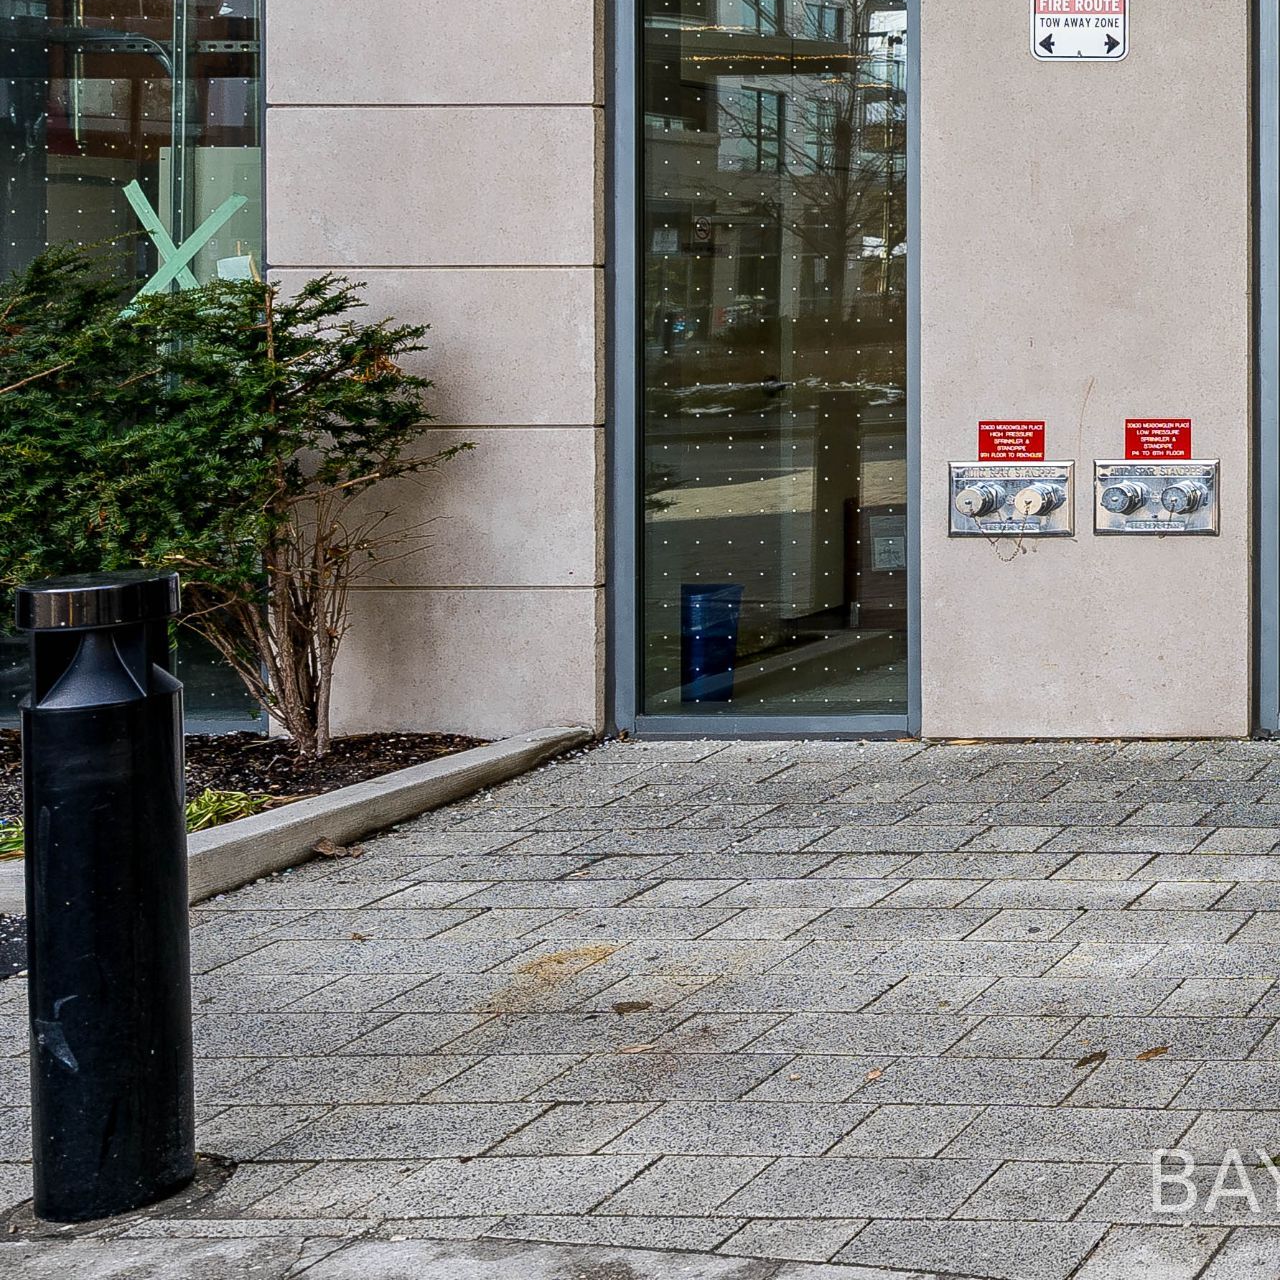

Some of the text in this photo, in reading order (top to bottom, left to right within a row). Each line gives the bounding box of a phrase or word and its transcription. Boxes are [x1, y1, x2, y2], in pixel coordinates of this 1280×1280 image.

[1040, 18, 1120, 28] TOW AWAY ZONE
